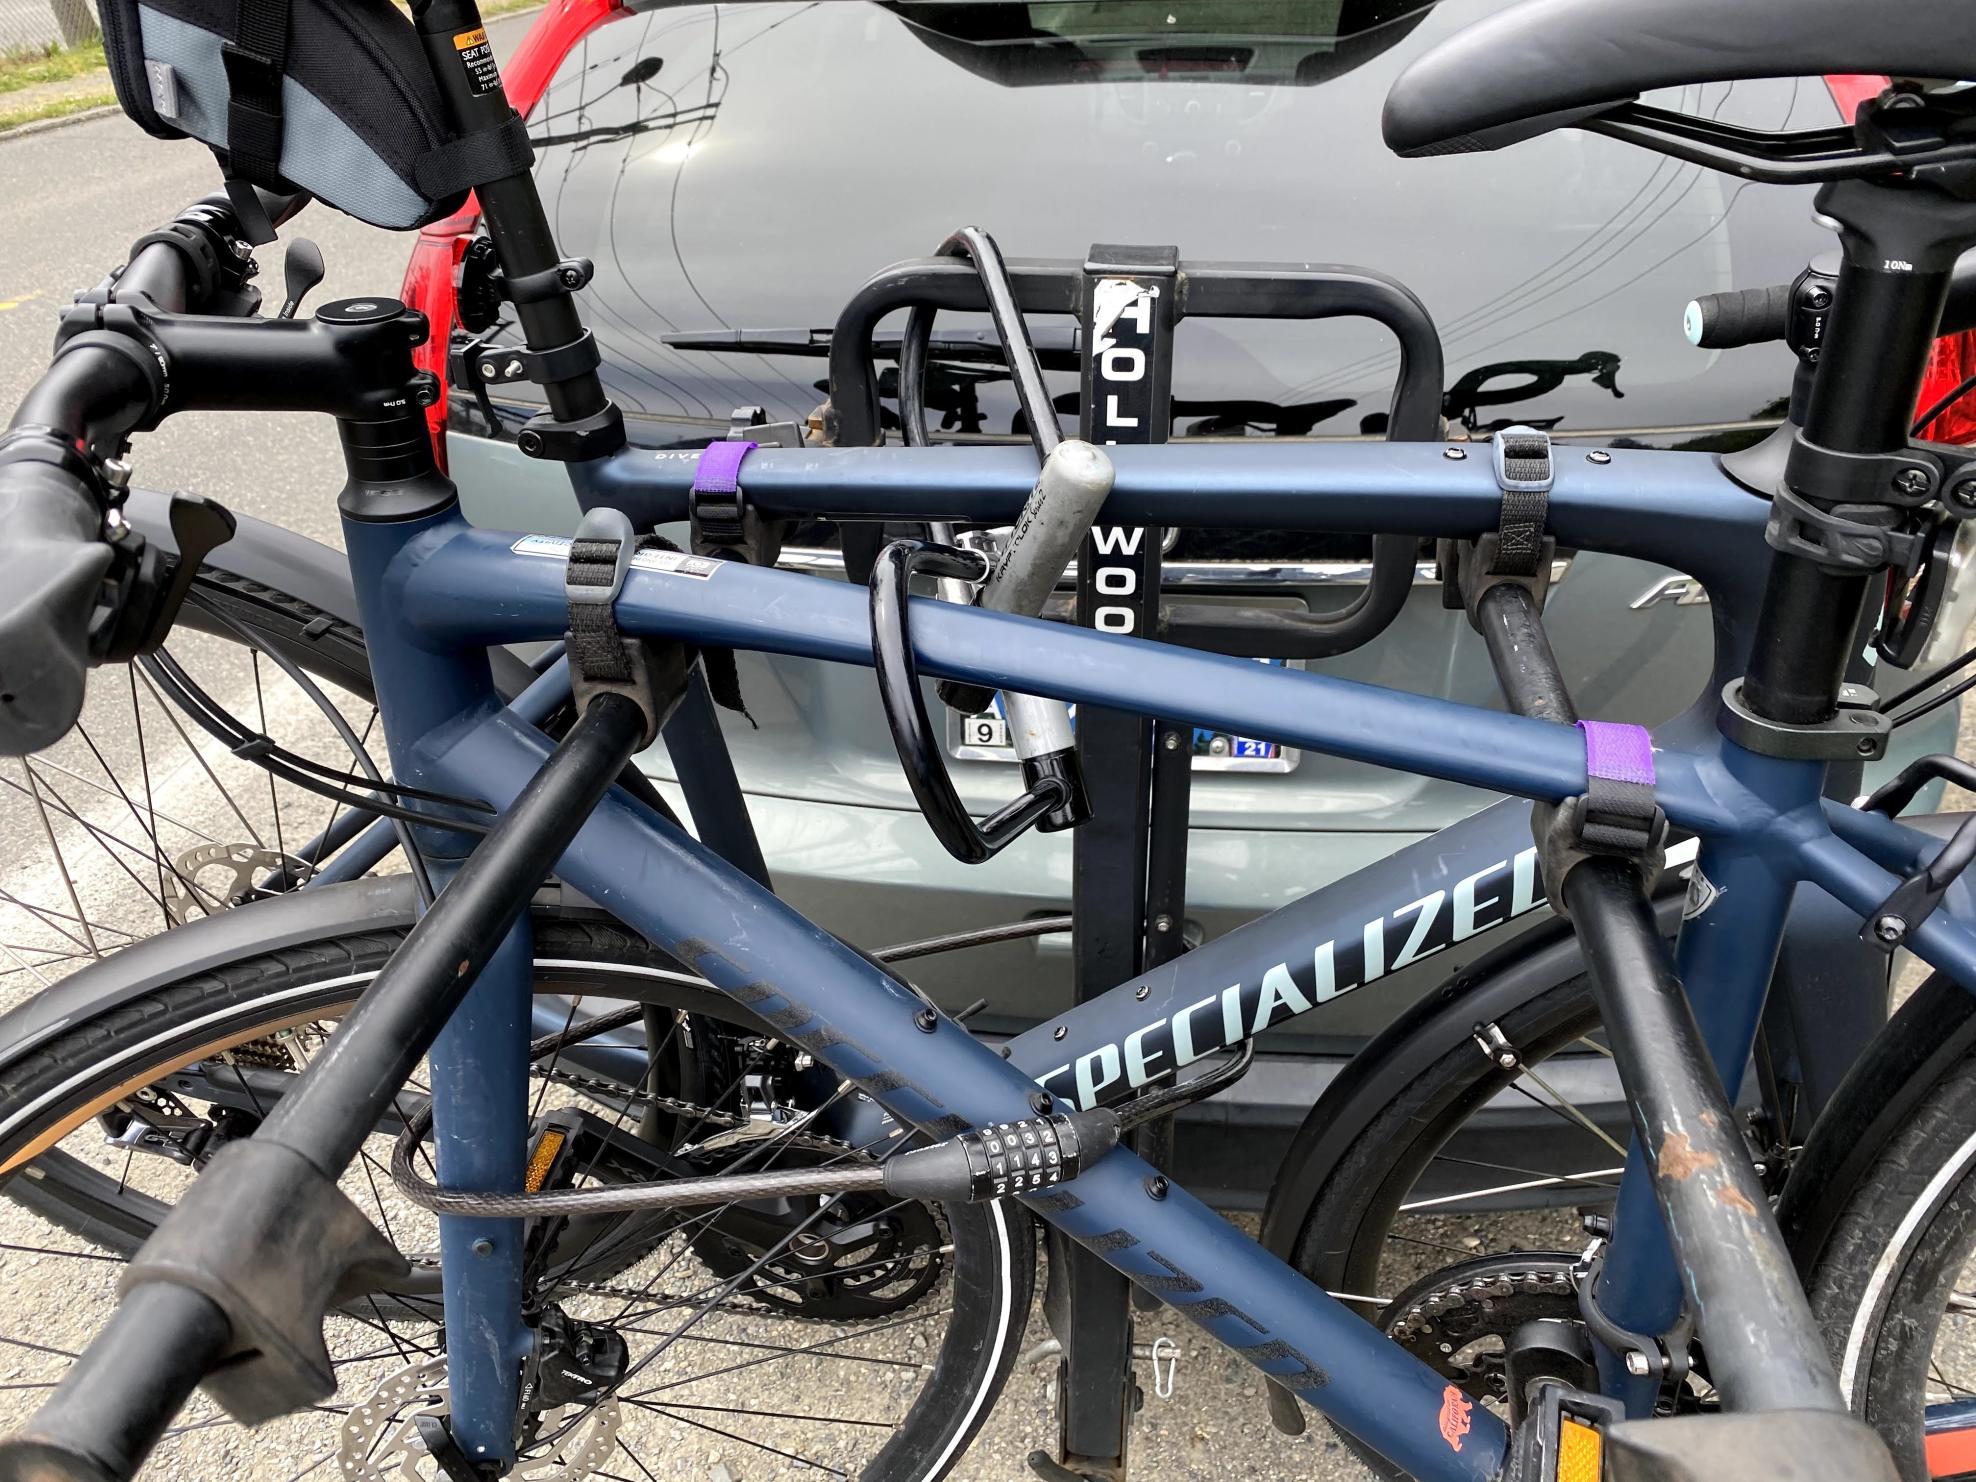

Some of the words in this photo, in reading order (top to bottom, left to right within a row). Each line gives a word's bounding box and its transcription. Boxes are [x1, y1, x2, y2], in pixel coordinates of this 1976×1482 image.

[462, 48, 479, 60] SEAT
[977, 723, 993, 743] 9
[1244, 742, 1266, 757] 21
